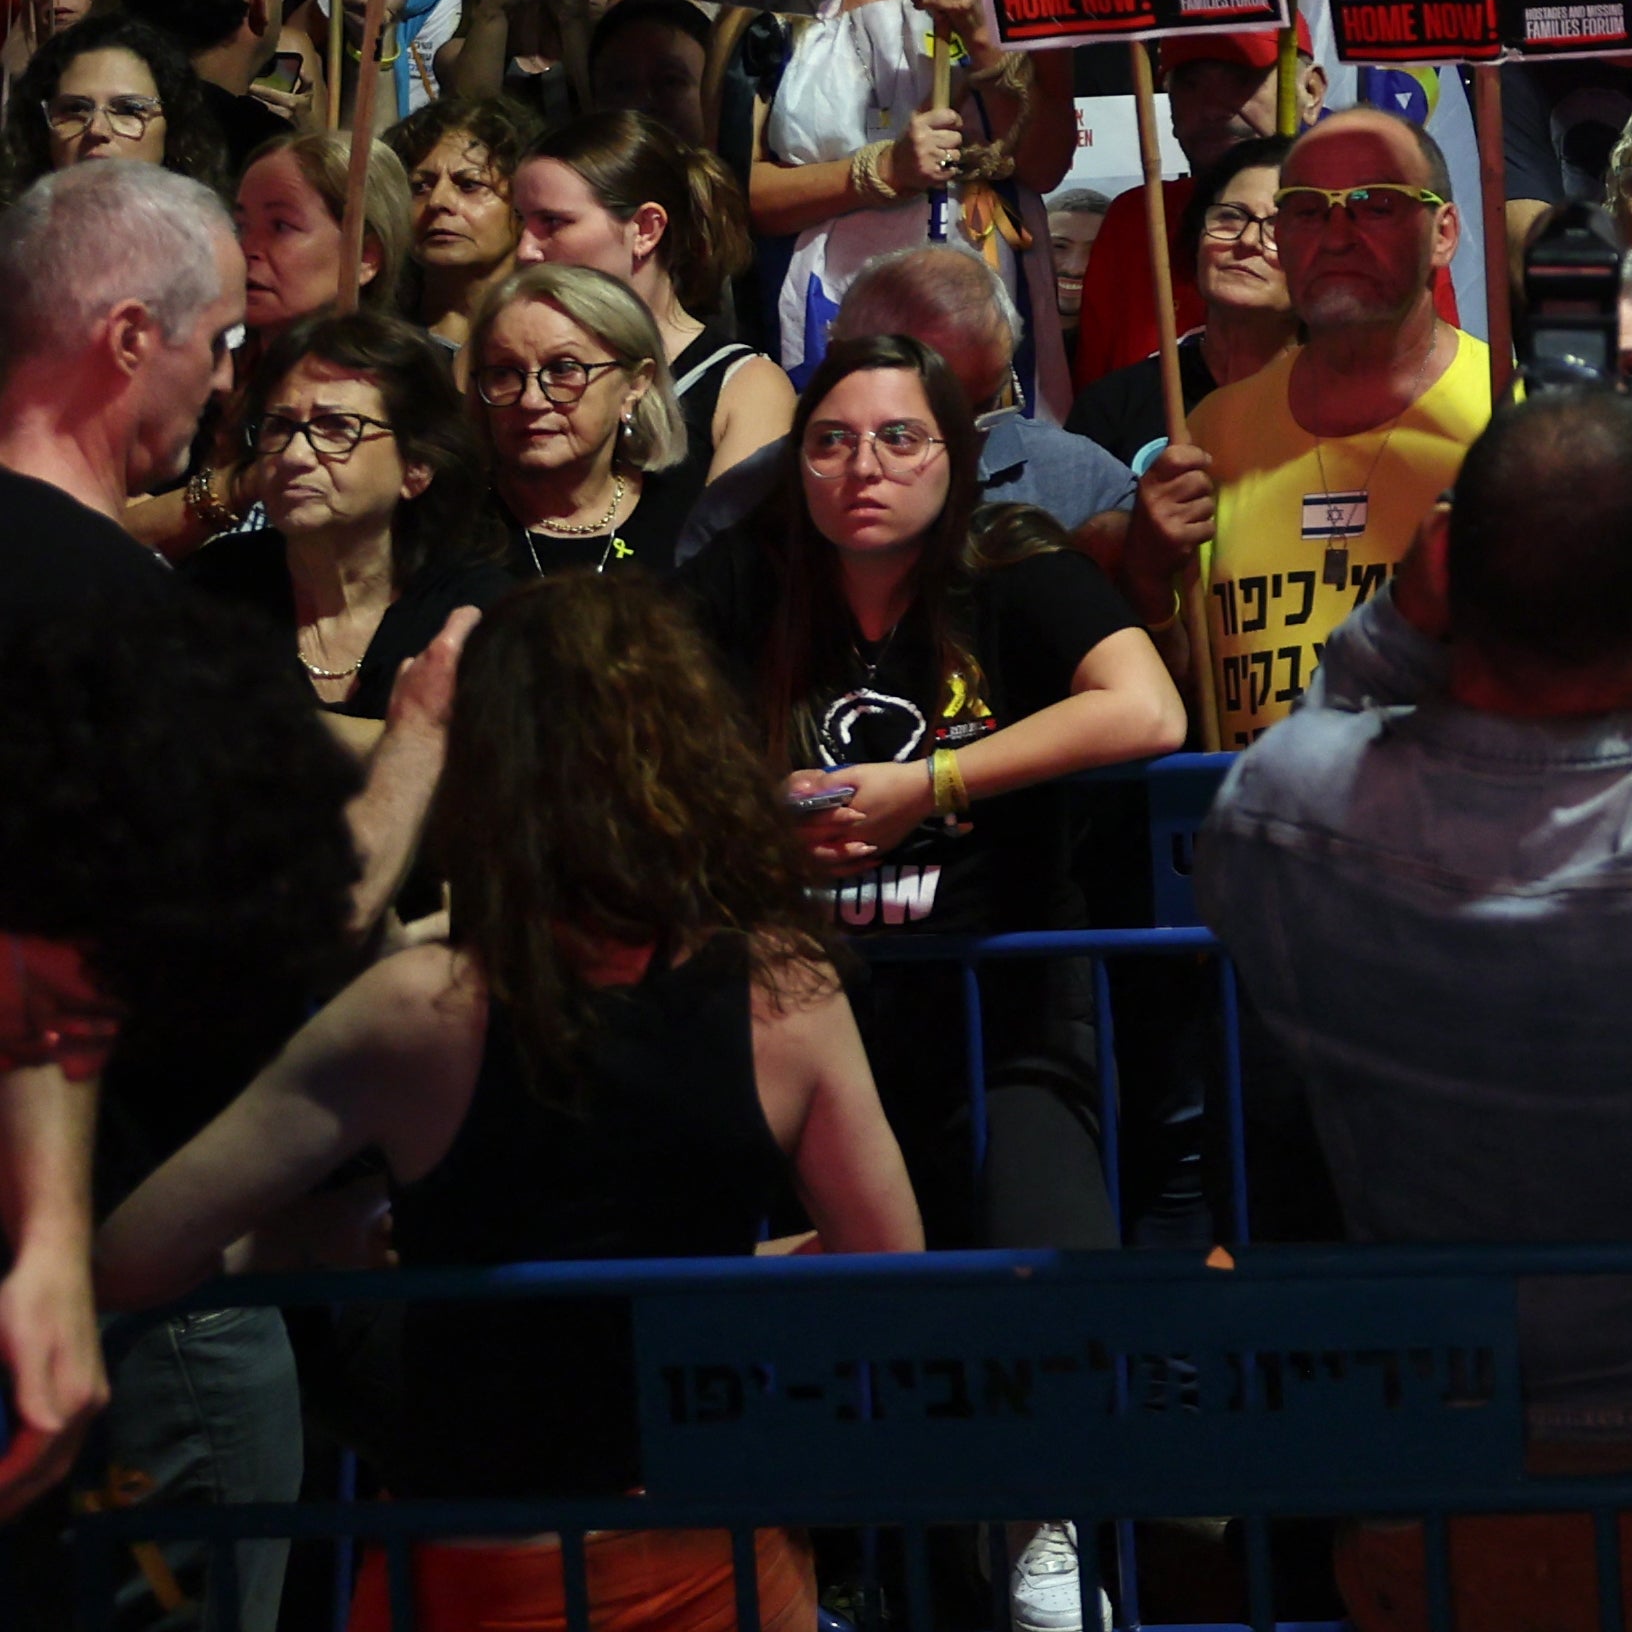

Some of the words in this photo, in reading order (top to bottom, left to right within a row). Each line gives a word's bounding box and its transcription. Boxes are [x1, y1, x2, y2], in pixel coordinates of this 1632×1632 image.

[1342, 5, 1417, 42] HOME
[1526, 20, 1580, 39] FAMILIES
[1582, 17, 1625, 36] FORUM
[1213, 571, 1315, 636] כיפור
